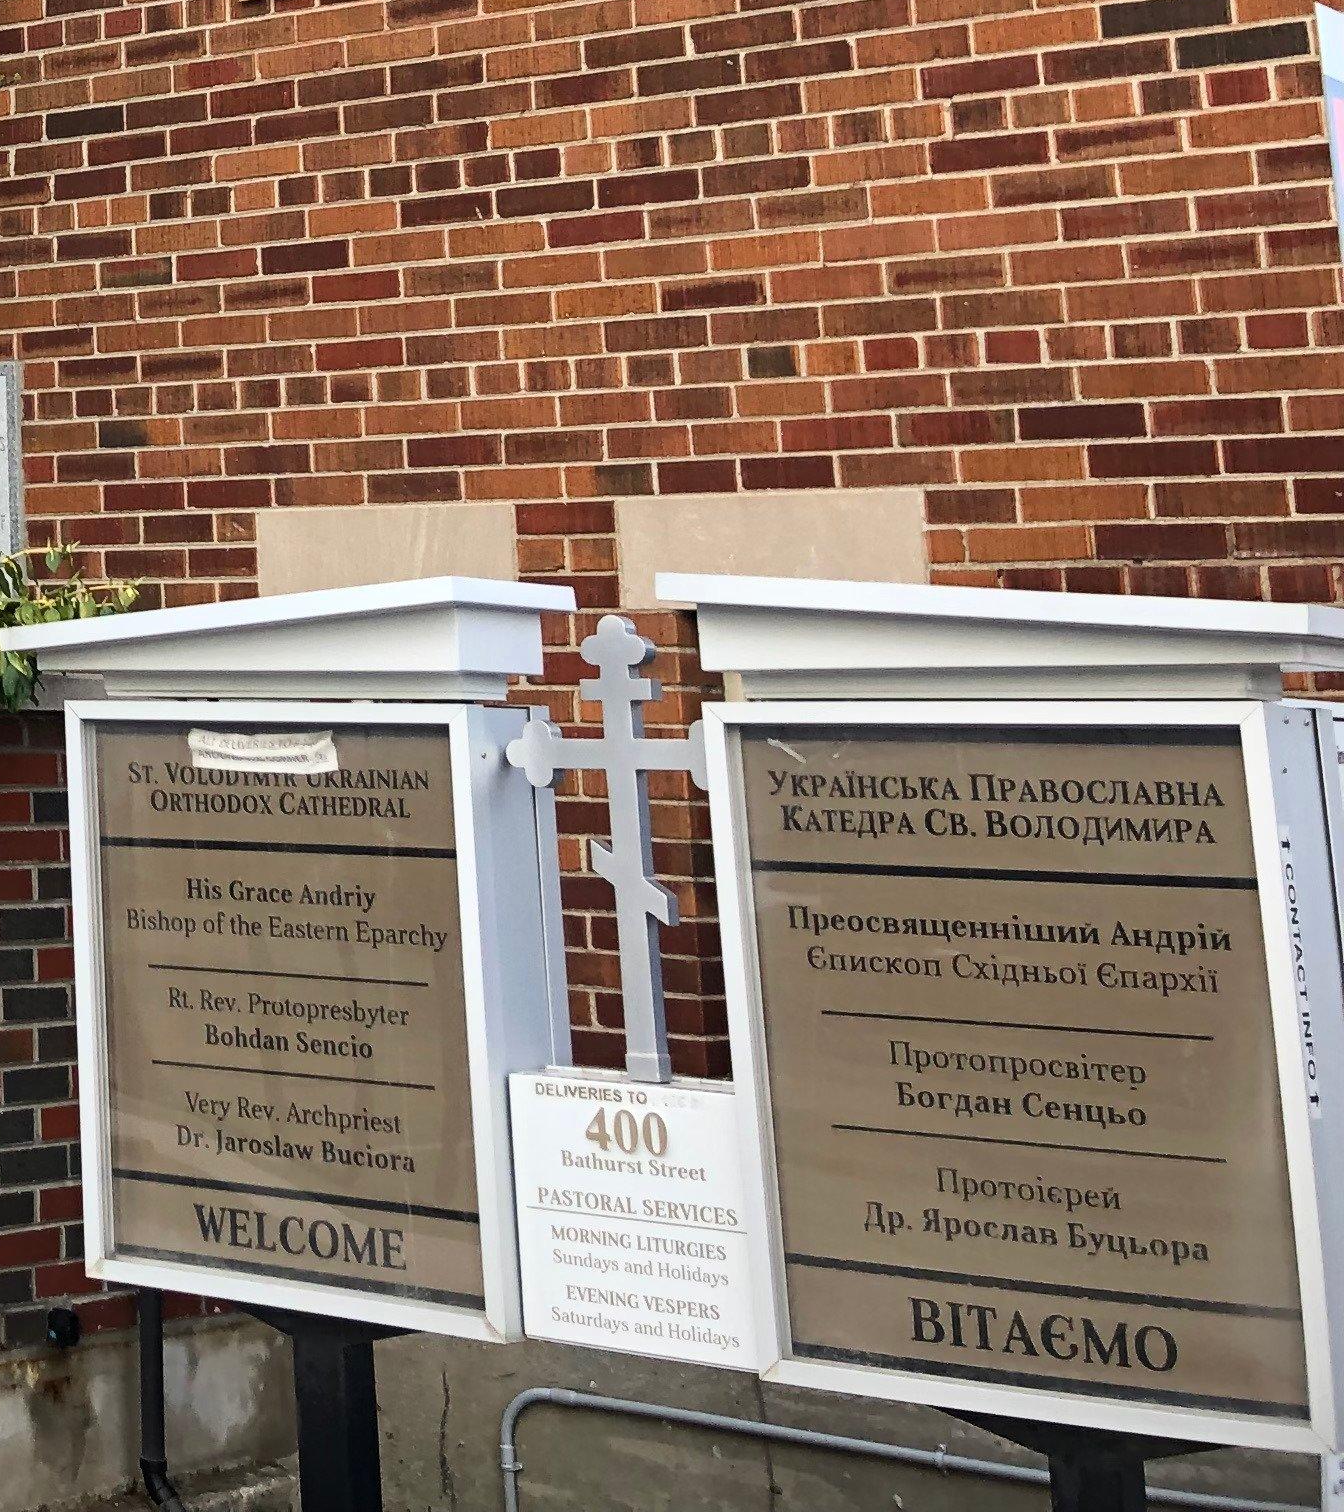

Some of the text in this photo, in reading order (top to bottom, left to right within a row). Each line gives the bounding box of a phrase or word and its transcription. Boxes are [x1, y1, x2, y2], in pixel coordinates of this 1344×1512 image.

[128, 760, 158, 784] ST.
[307, 769, 430, 790] UKRAINIAN
[767, 769, 1226, 808] УКРАЇНСЬКА ПРАВОСЛАВНА
[150, 789, 411, 819] ORTHODOX CATHEDRAL
[781, 804, 1217, 846] КАТЕДРА СВ. ВОЛОДИМИРА
[186, 877, 376, 913] His Grace Andriy
[126, 909, 448, 952] Bishop of the Eastern Eparchy
[788, 905, 1232, 956] Преосвященніший Андрій
[807, 945, 1220, 998] Єпископ Східньої Єпархії
[1284, 862, 1317, 1081] CONTACT INFO
[168, 987, 410, 1029] Rt. Rev. Protopresbyter
[205, 1024, 373, 1059] Bohdan Sencio
[888, 1039, 1148, 1091] Протопросвітер
[184, 1090, 402, 1135] Very Rev. Archpriest
[534, 1082, 648, 1105] DELIVERIES TO
[896, 1081, 1148, 1129] Богдан Сенцьо
[175, 1123, 416, 1173] Dr. Jaroslaw Buciora
[585, 1106, 670, 1157] 400
[560, 1149, 707, 1182] Bathurst Street
[537, 1186, 739, 1227] PASTORAL SERVICES
[937, 1166, 1122, 1212] Протоієрей
[193, 1202, 407, 1271] WELCOME
[551, 1224, 728, 1261] MORNING LITURGIES
[864, 1201, 1209, 1266] Др. Ярослав Буцьора
[552, 1248, 729, 1288] Sundays and Holidays
[565, 1284, 721, 1321] EVENING VESPERS
[551, 1306, 741, 1351] Saturdays and Holidays
[908, 1296, 1179, 1372] ВІТАЄМО
